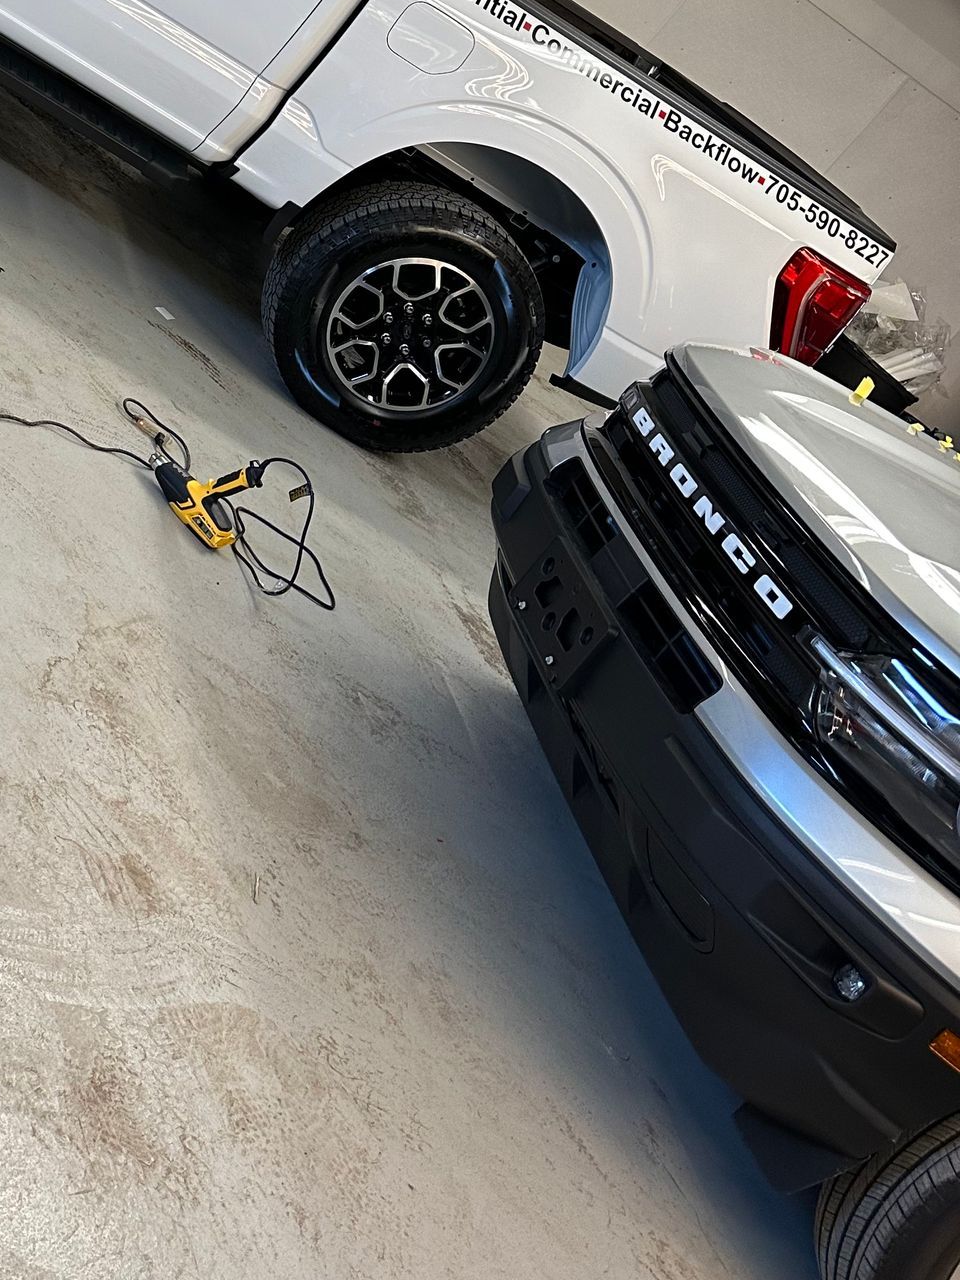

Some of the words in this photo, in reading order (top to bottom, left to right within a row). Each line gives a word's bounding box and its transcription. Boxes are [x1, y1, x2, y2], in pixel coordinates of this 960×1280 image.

[530, 23, 661, 121] Commercial
[663, 109, 761, 187] Backflow
[763, 173, 891, 270] 705-590-8227
[632, 406, 794, 620] BRONCO
